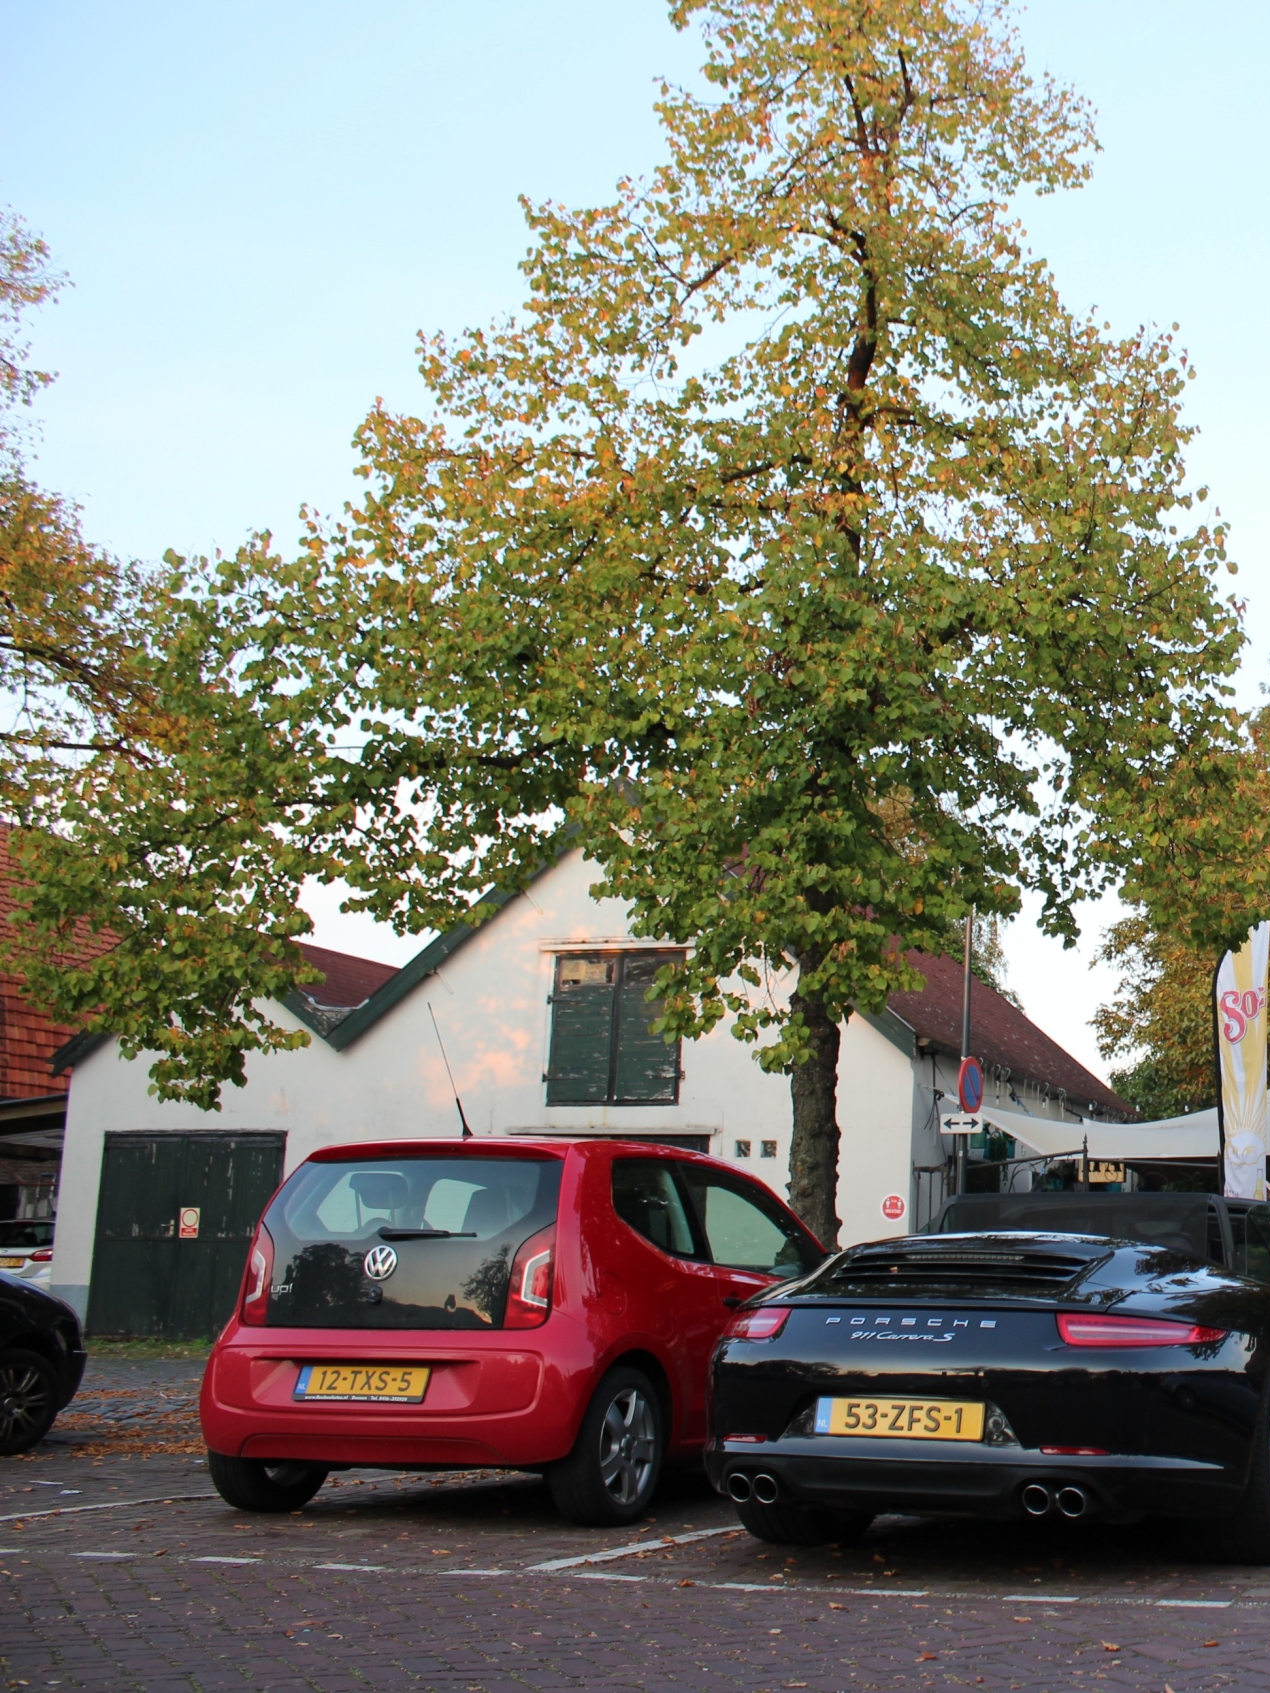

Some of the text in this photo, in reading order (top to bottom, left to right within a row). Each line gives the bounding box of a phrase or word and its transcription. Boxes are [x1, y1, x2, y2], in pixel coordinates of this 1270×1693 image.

[271, 1283, 293, 1294] up!
[826, 1317, 997, 1328] PORSCHE
[851, 1331, 956, 1342] 911 Carrera S
[319, 1370, 413, 1392] 12-TXS-5
[817, 1403, 963, 1433] NL 53-ZFS-1
